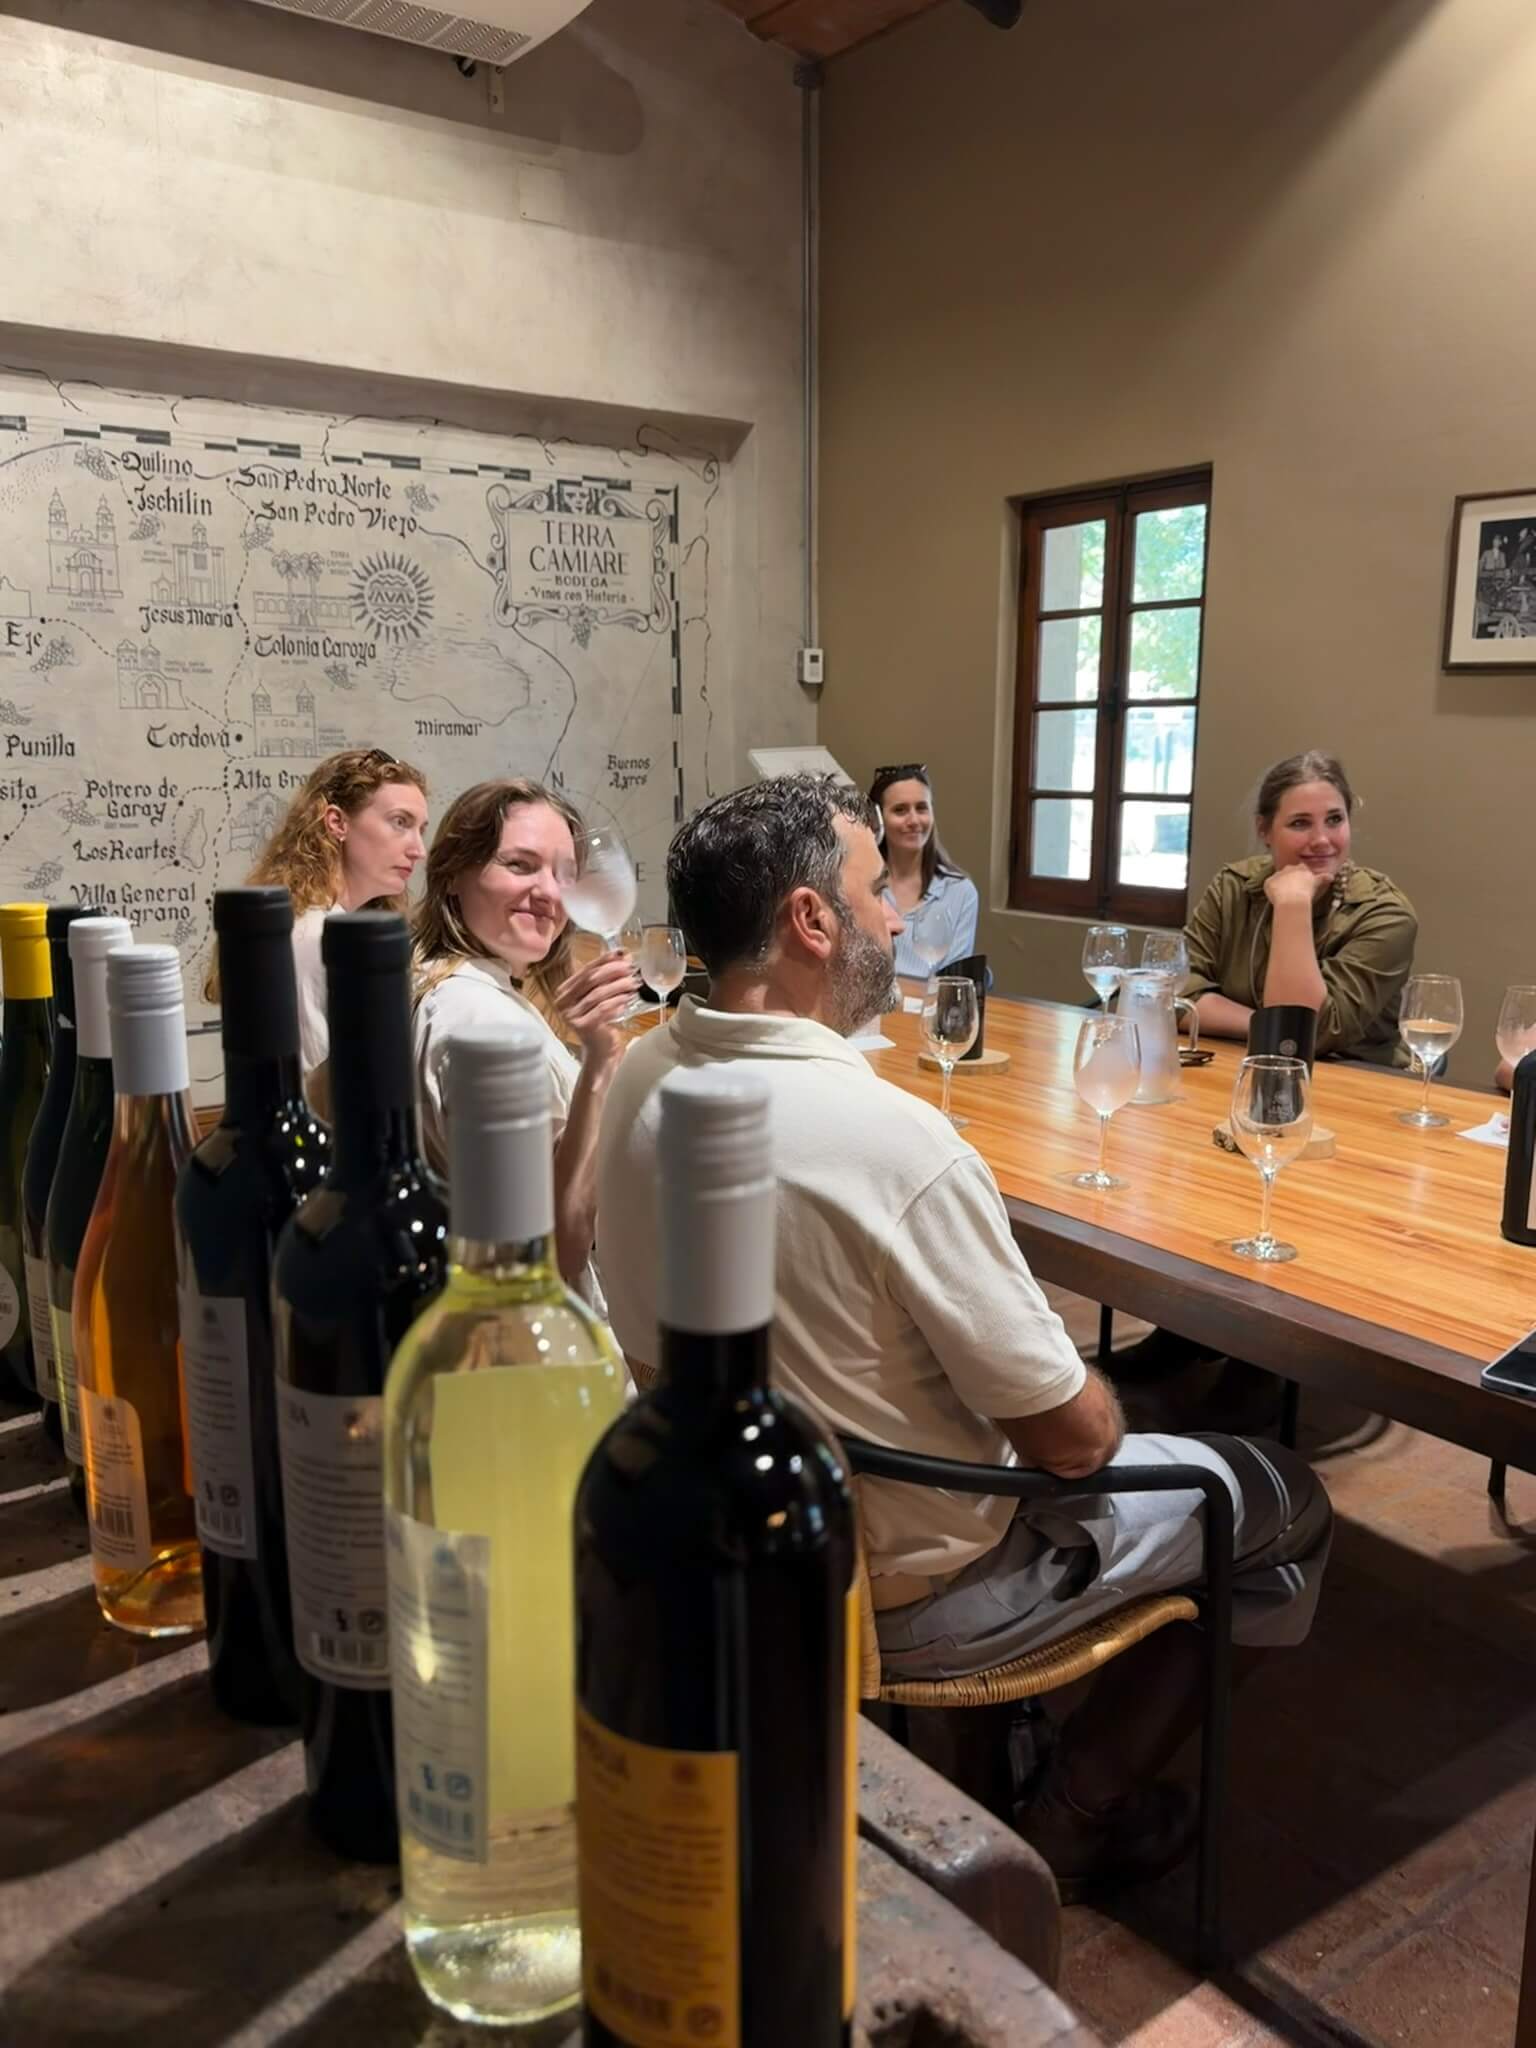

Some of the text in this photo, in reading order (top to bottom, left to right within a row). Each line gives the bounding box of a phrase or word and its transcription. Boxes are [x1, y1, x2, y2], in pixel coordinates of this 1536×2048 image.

[121, 451, 193, 480] Quilino
[233, 466, 392, 500] San Pedro Norte
[254, 500, 417, 539] San Pedro Viejo
[541, 519, 616, 548] TERRA
[529, 545, 631, 576] CAMIARE
[555, 575, 608, 588] BODEGA
[139, 605, 185, 633] Jesus
[186, 608, 234, 628] Maria
[6, 621, 43, 655] Eje
[254, 634, 377, 668] Colonia Caroya
[147, 722, 231, 748] Cordova
[414, 717, 483, 737] Miramar
[5, 733, 76, 758] Punilla
[607, 754, 651, 770] Buenos
[83, 775, 178, 799] Potrero de
[233, 768, 272, 790] Alta
[552, 771, 565, 789] N
[107, 800, 167, 828] Garay
[72, 839, 177, 861] Los Reartes
[635, 862, 647, 882] E
[69, 881, 196, 905] Villa General
